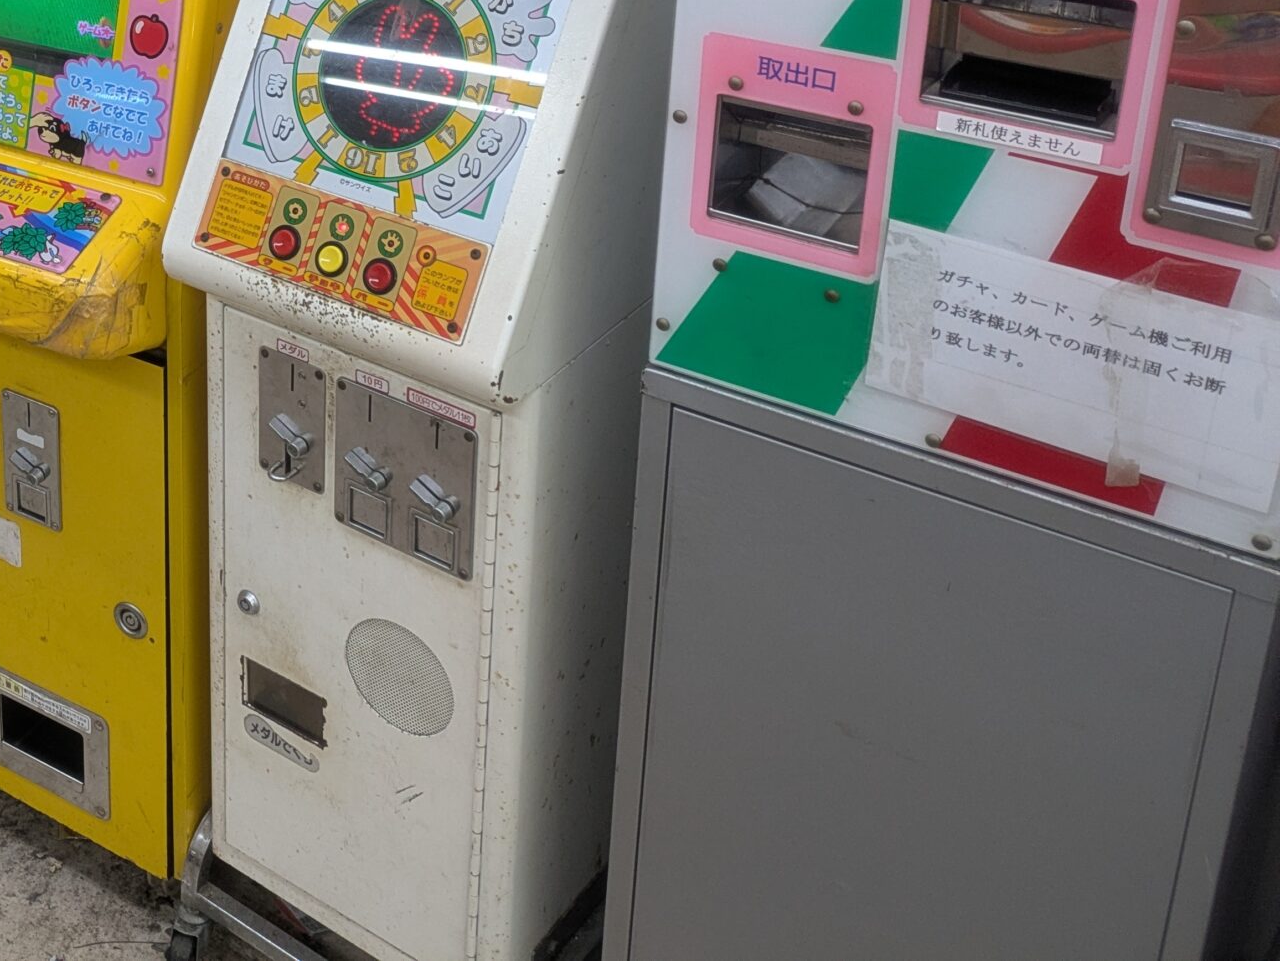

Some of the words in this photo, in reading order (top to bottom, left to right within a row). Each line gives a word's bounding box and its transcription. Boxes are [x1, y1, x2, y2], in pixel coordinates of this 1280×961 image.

[756, 56, 836, 92] 取出口
[70, 75, 150, 105] ひろってきたら
[68, 95, 148, 125] ボタンでなでて
[266, 74, 295, 139] まけ
[954, 117, 1082, 158] 新札使えません
[234, 174, 267, 190] あそびかた
[422, 277, 459, 294] ついたときは
[424, 268, 462, 285] このランプが
[937, 270, 1232, 364] ガチャ、カード、ゲーム機ご利用
[280, 343, 306, 359] メダル
[930, 326, 1024, 368] り致します。
[932, 300, 1227, 395] のお客様以外での両替は固くお断
[362, 374, 383, 389] 10円
